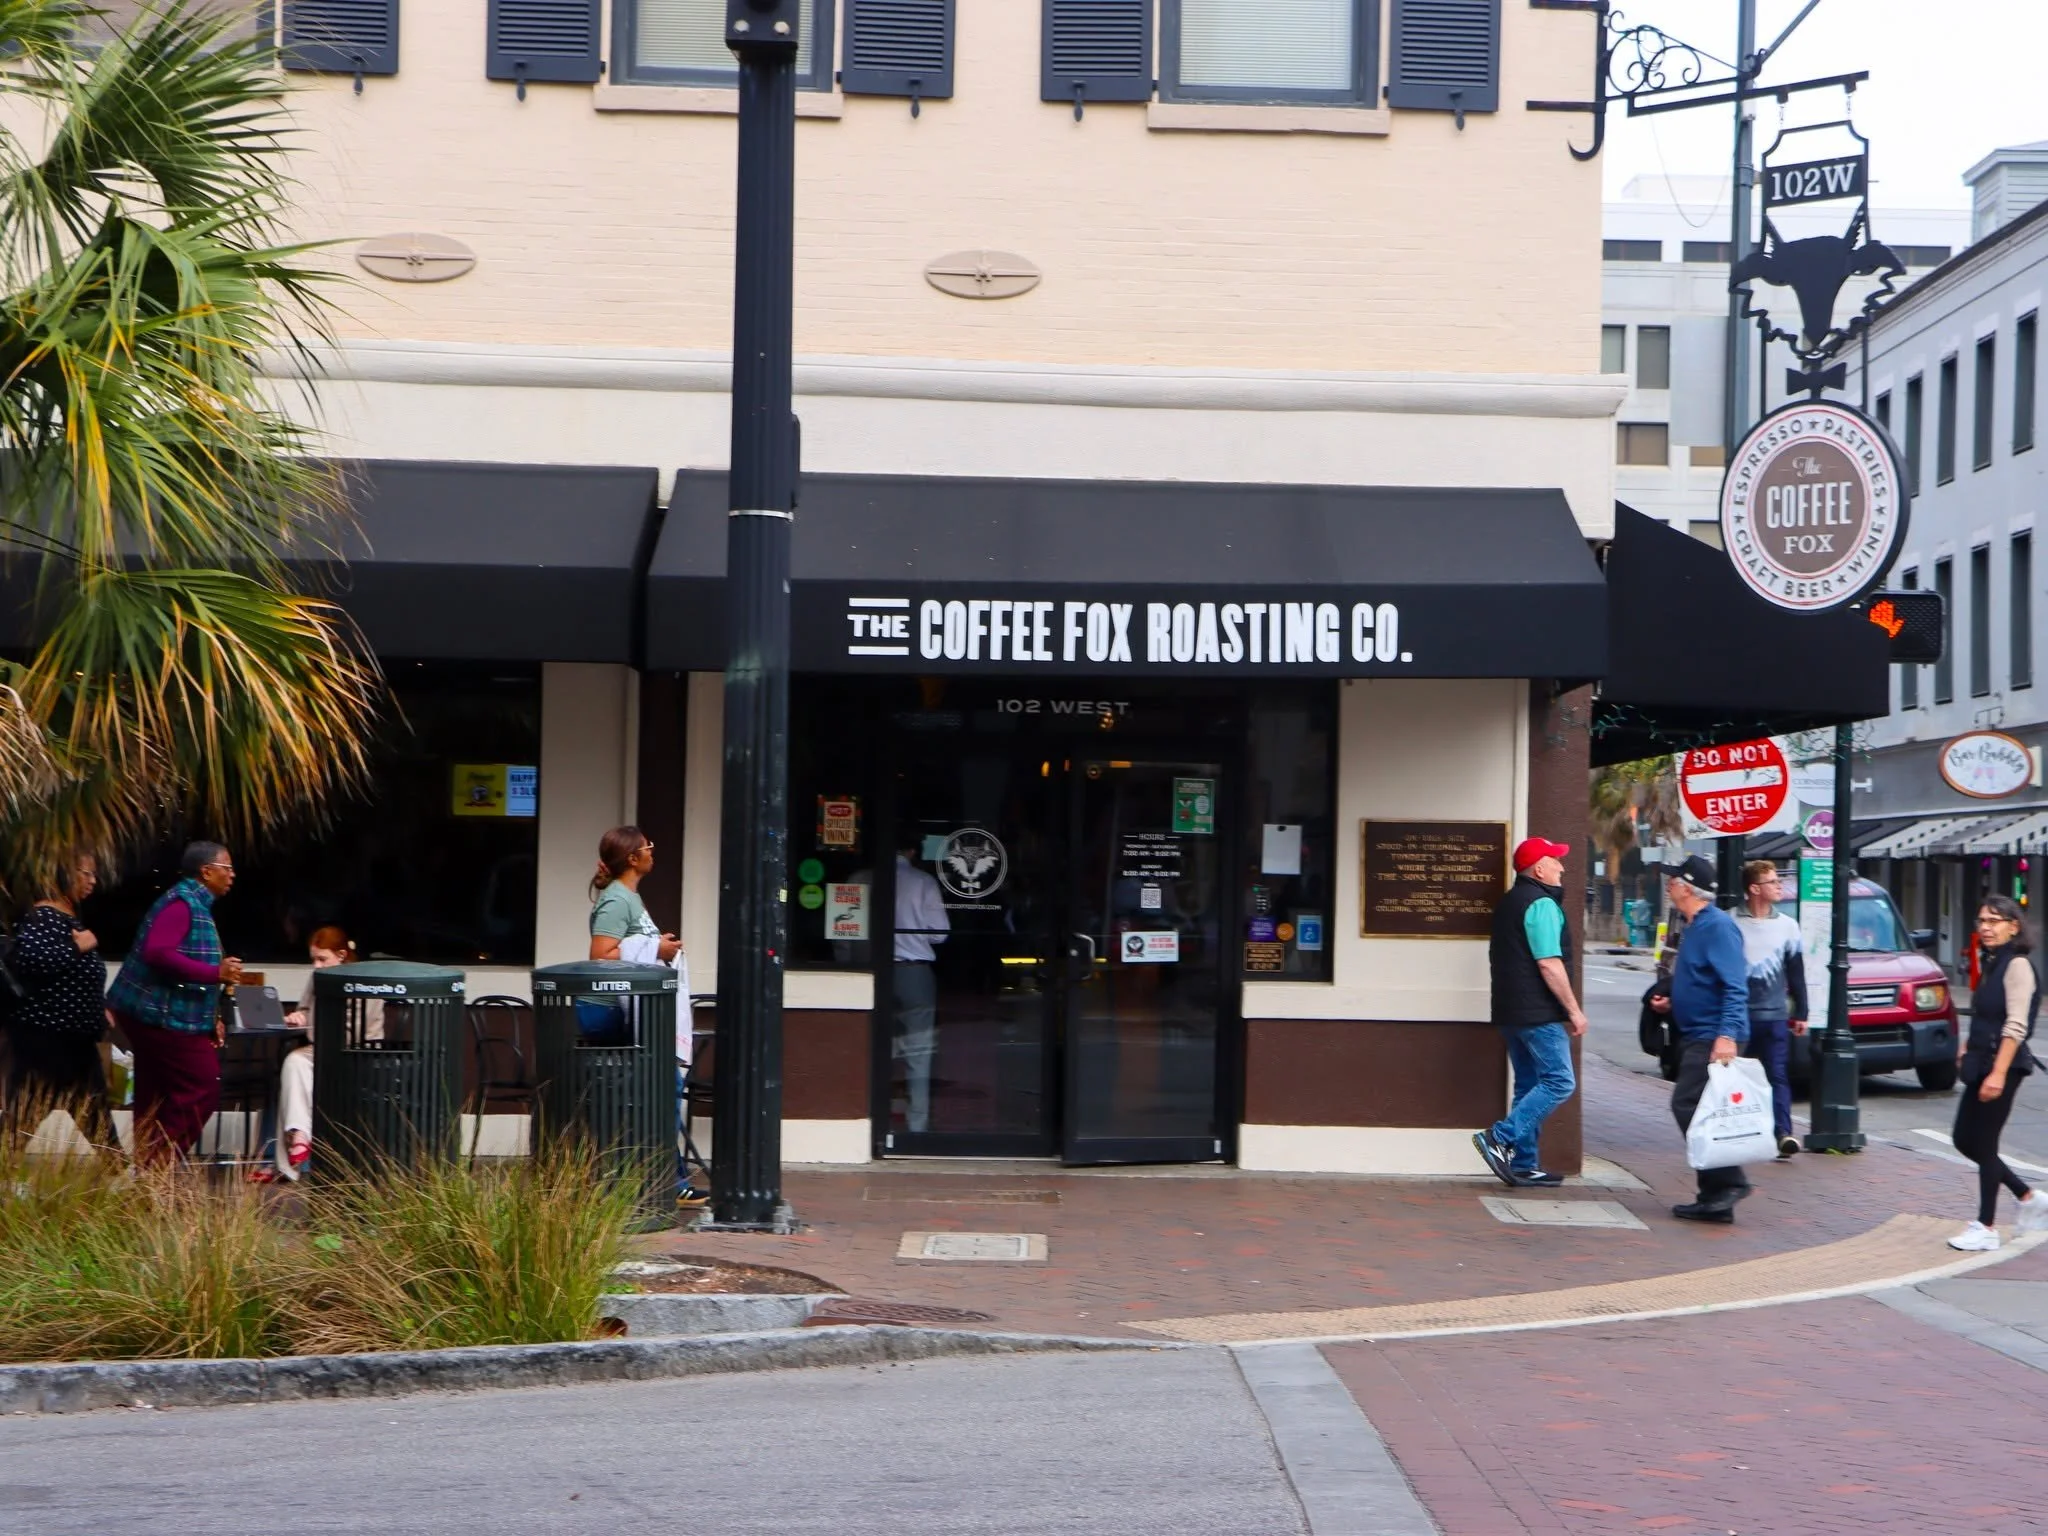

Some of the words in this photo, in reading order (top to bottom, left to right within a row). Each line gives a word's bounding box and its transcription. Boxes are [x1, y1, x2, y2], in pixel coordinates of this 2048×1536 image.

[1771, 162, 1858, 201] 102W
[1733, 418, 1803, 507] ESPRESSO
[1791, 456, 1824, 477] The
[1823, 418, 1888, 498] PASTRIES
[1766, 481, 1853, 529] COFFEE
[1783, 533, 1835, 555] FOX
[1847, 521, 1885, 575] WINE
[1735, 528, 1780, 588] CRAFT
[1783, 578, 1834, 598] BEER
[847, 614, 910, 638] THE
[920, 600, 1054, 661] COFFEE
[1063, 601, 1133, 662] FOX
[1147, 602, 1340, 663] ROASTING
[1351, 602, 1413, 663] CO.
[997, 699, 1041, 713] 102
[1050, 700, 1129, 715] WEST
[1693, 749, 1721, 768] DO
[1728, 744, 1769, 765] NOT
[1705, 793, 1769, 815] ENTER
[355, 983, 394, 994] Recycle
[591, 981, 631, 991] LITTER
